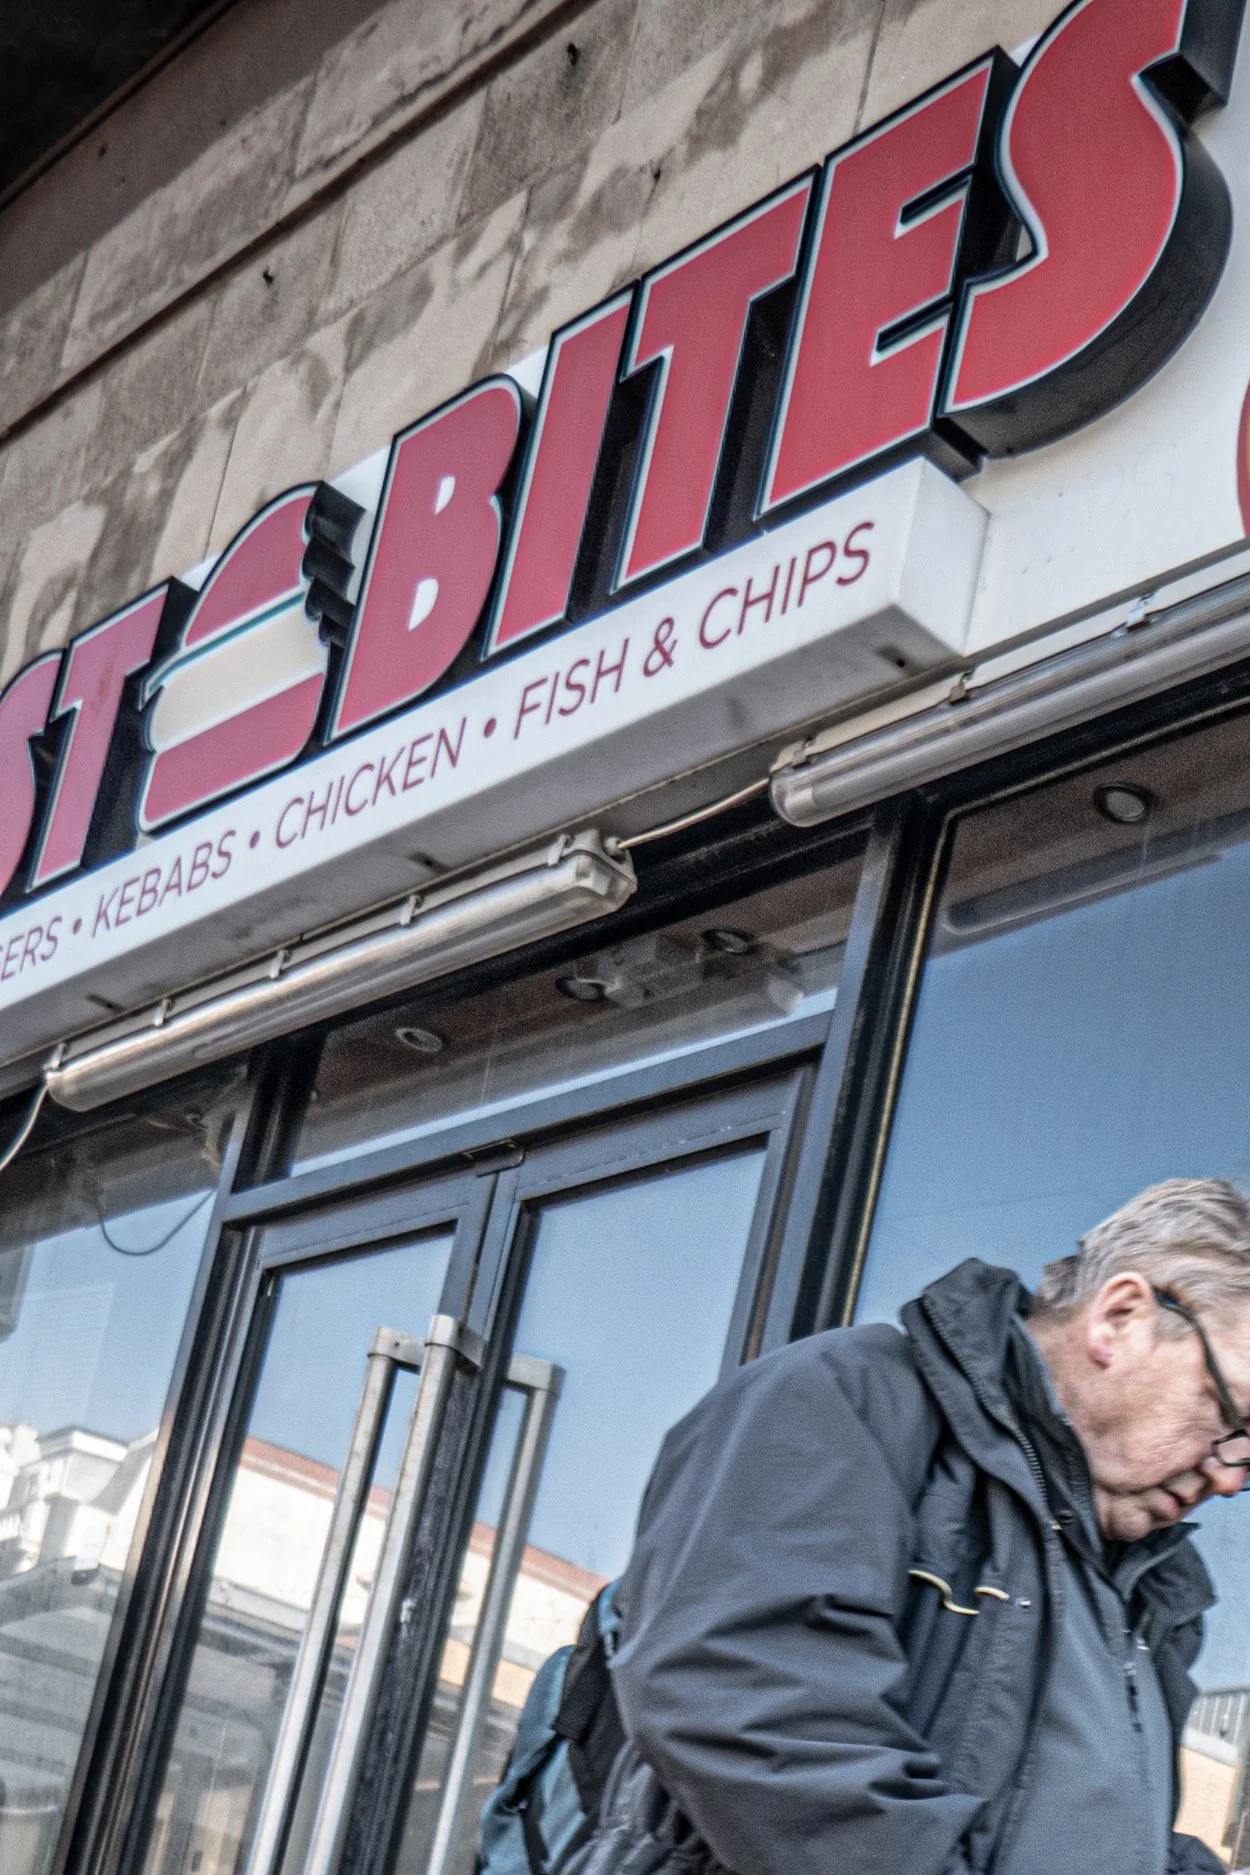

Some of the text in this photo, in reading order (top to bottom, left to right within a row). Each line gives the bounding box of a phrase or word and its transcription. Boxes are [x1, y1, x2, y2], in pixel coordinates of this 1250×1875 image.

[324, 0, 1195, 745] BITES
[0, 520, 875, 982] ERS KEBABS CHICKEN FISH & CHIPS
